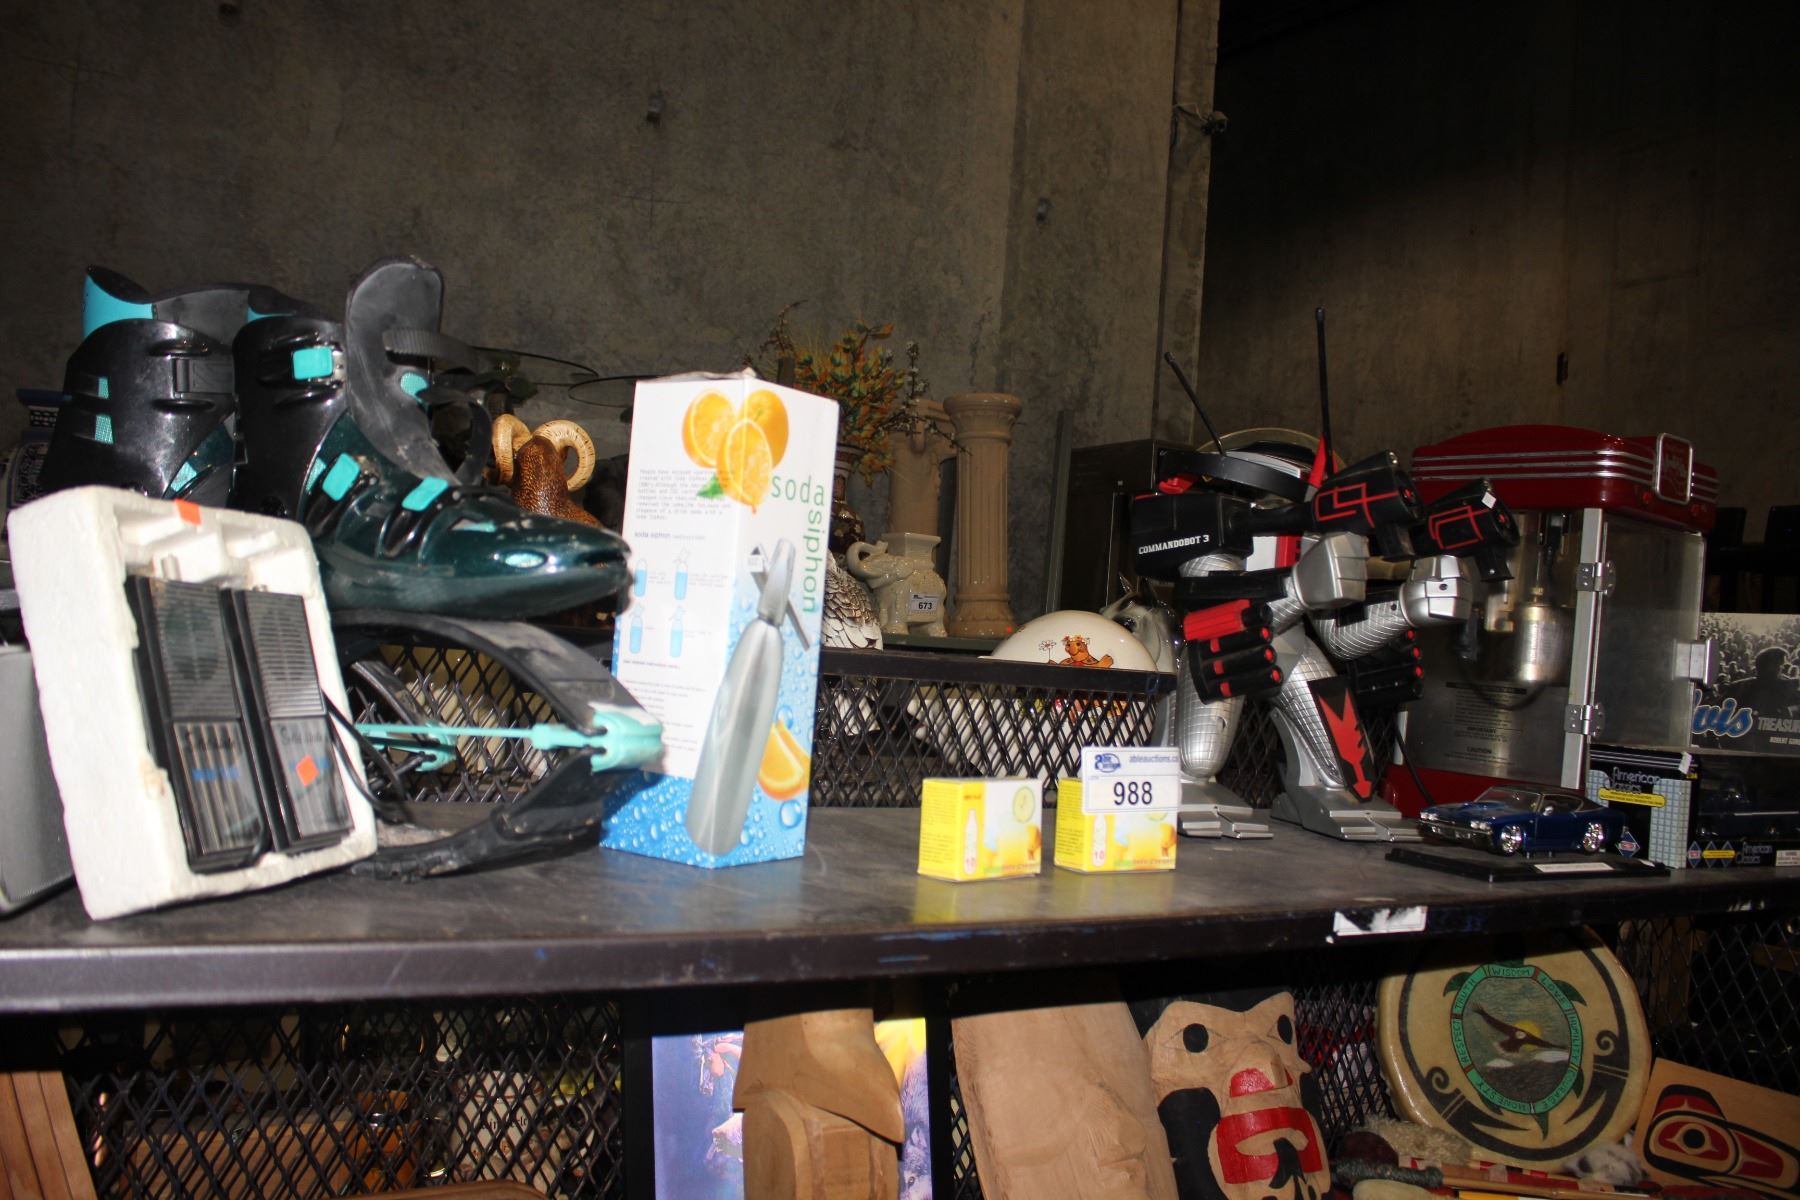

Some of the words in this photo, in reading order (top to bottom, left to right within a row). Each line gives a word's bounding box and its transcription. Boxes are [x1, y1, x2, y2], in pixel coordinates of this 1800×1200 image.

[771, 475, 825, 506] soda
[1138, 535, 1201, 554] COMMANDOBOT
[1203, 534, 1210, 543] 3
[802, 509, 826, 613] siphon
[918, 601, 933, 610] 673
[1612, 766, 1661, 785] American
[1113, 781, 1153, 806] 988
[1493, 967, 1531, 977] WISDOM
[1455, 979, 1476, 1010] TRUTH
[1541, 976, 1569, 1004] LOVE
[1453, 1020, 1470, 1063] RESPECT
[1568, 1016, 1580, 1062] HUMILITY
[1476, 1080, 1528, 1112] HONESTY
[1542, 1069, 1576, 1110] COURAGE
